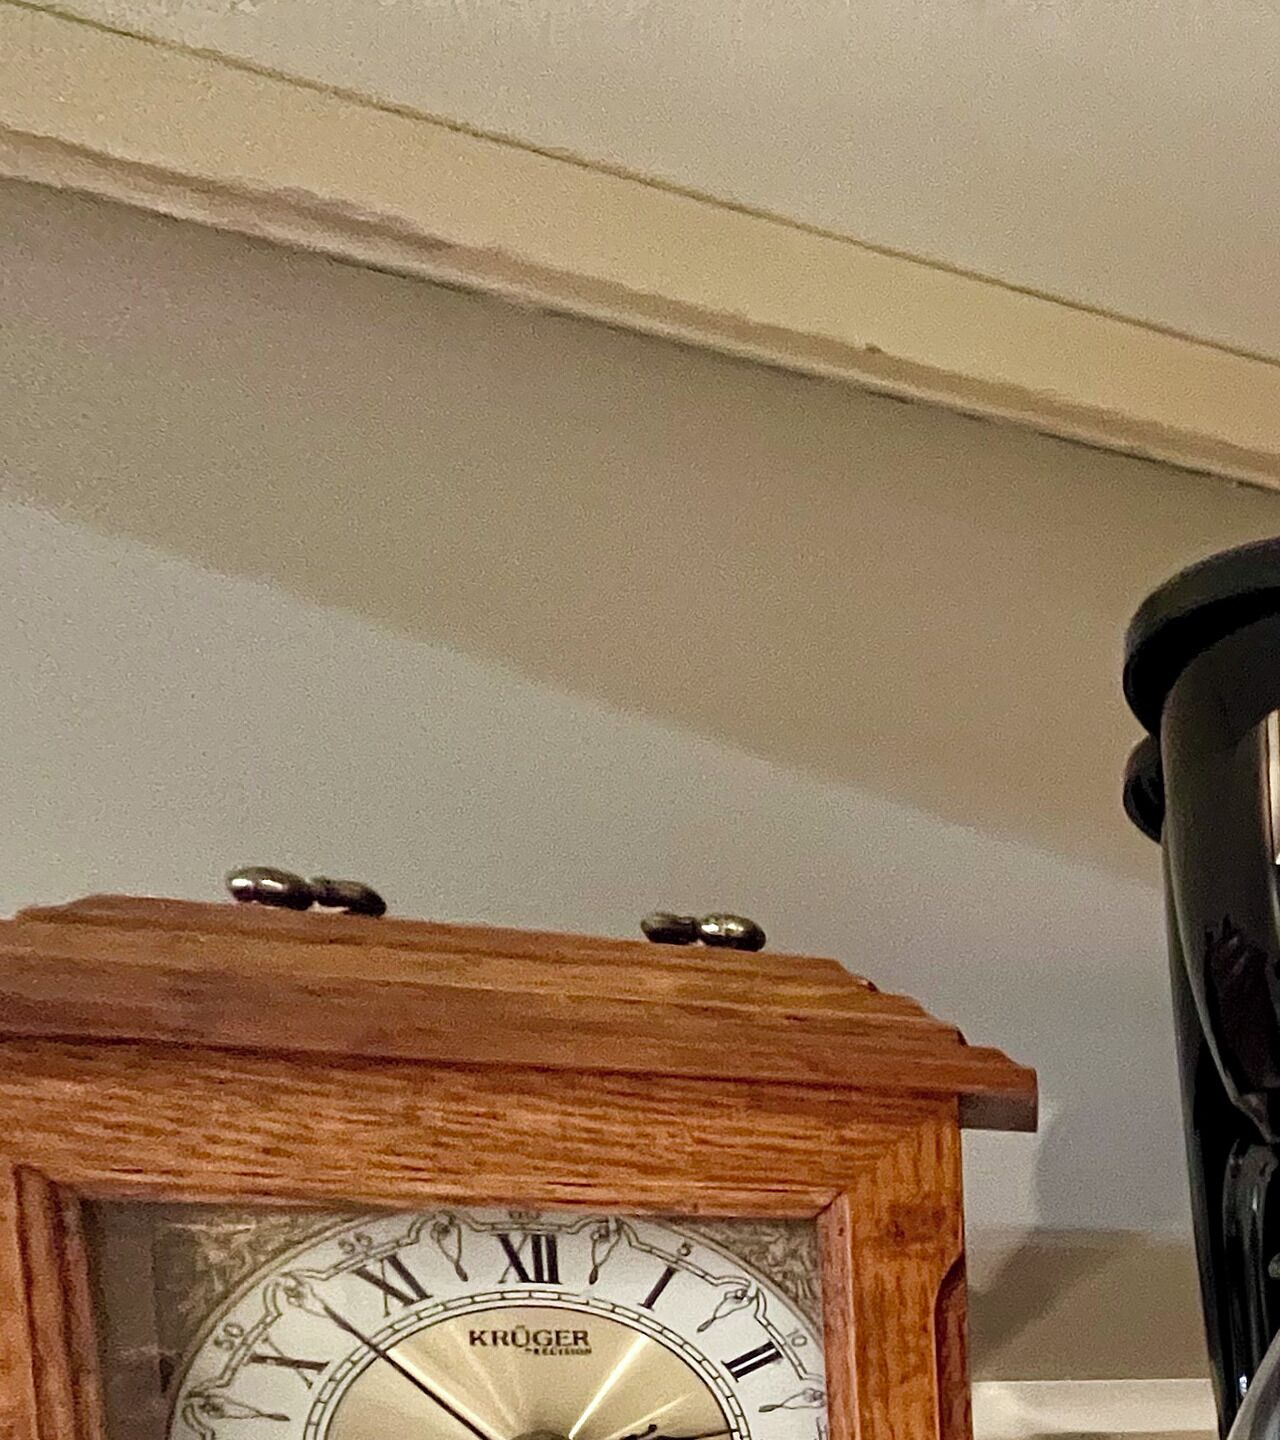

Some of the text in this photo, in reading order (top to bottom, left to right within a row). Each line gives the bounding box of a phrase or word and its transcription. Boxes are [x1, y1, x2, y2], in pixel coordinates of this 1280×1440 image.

[338, 1233, 372, 1253] 55
[677, 1243, 692, 1257] 5
[491, 1234, 562, 1284] XII
[351, 1255, 433, 1317] XI
[214, 1322, 244, 1350] 50
[469, 1325, 589, 1347] KRÜGER
[786, 1328, 808, 1348] 10
[721, 1339, 783, 1382] II
